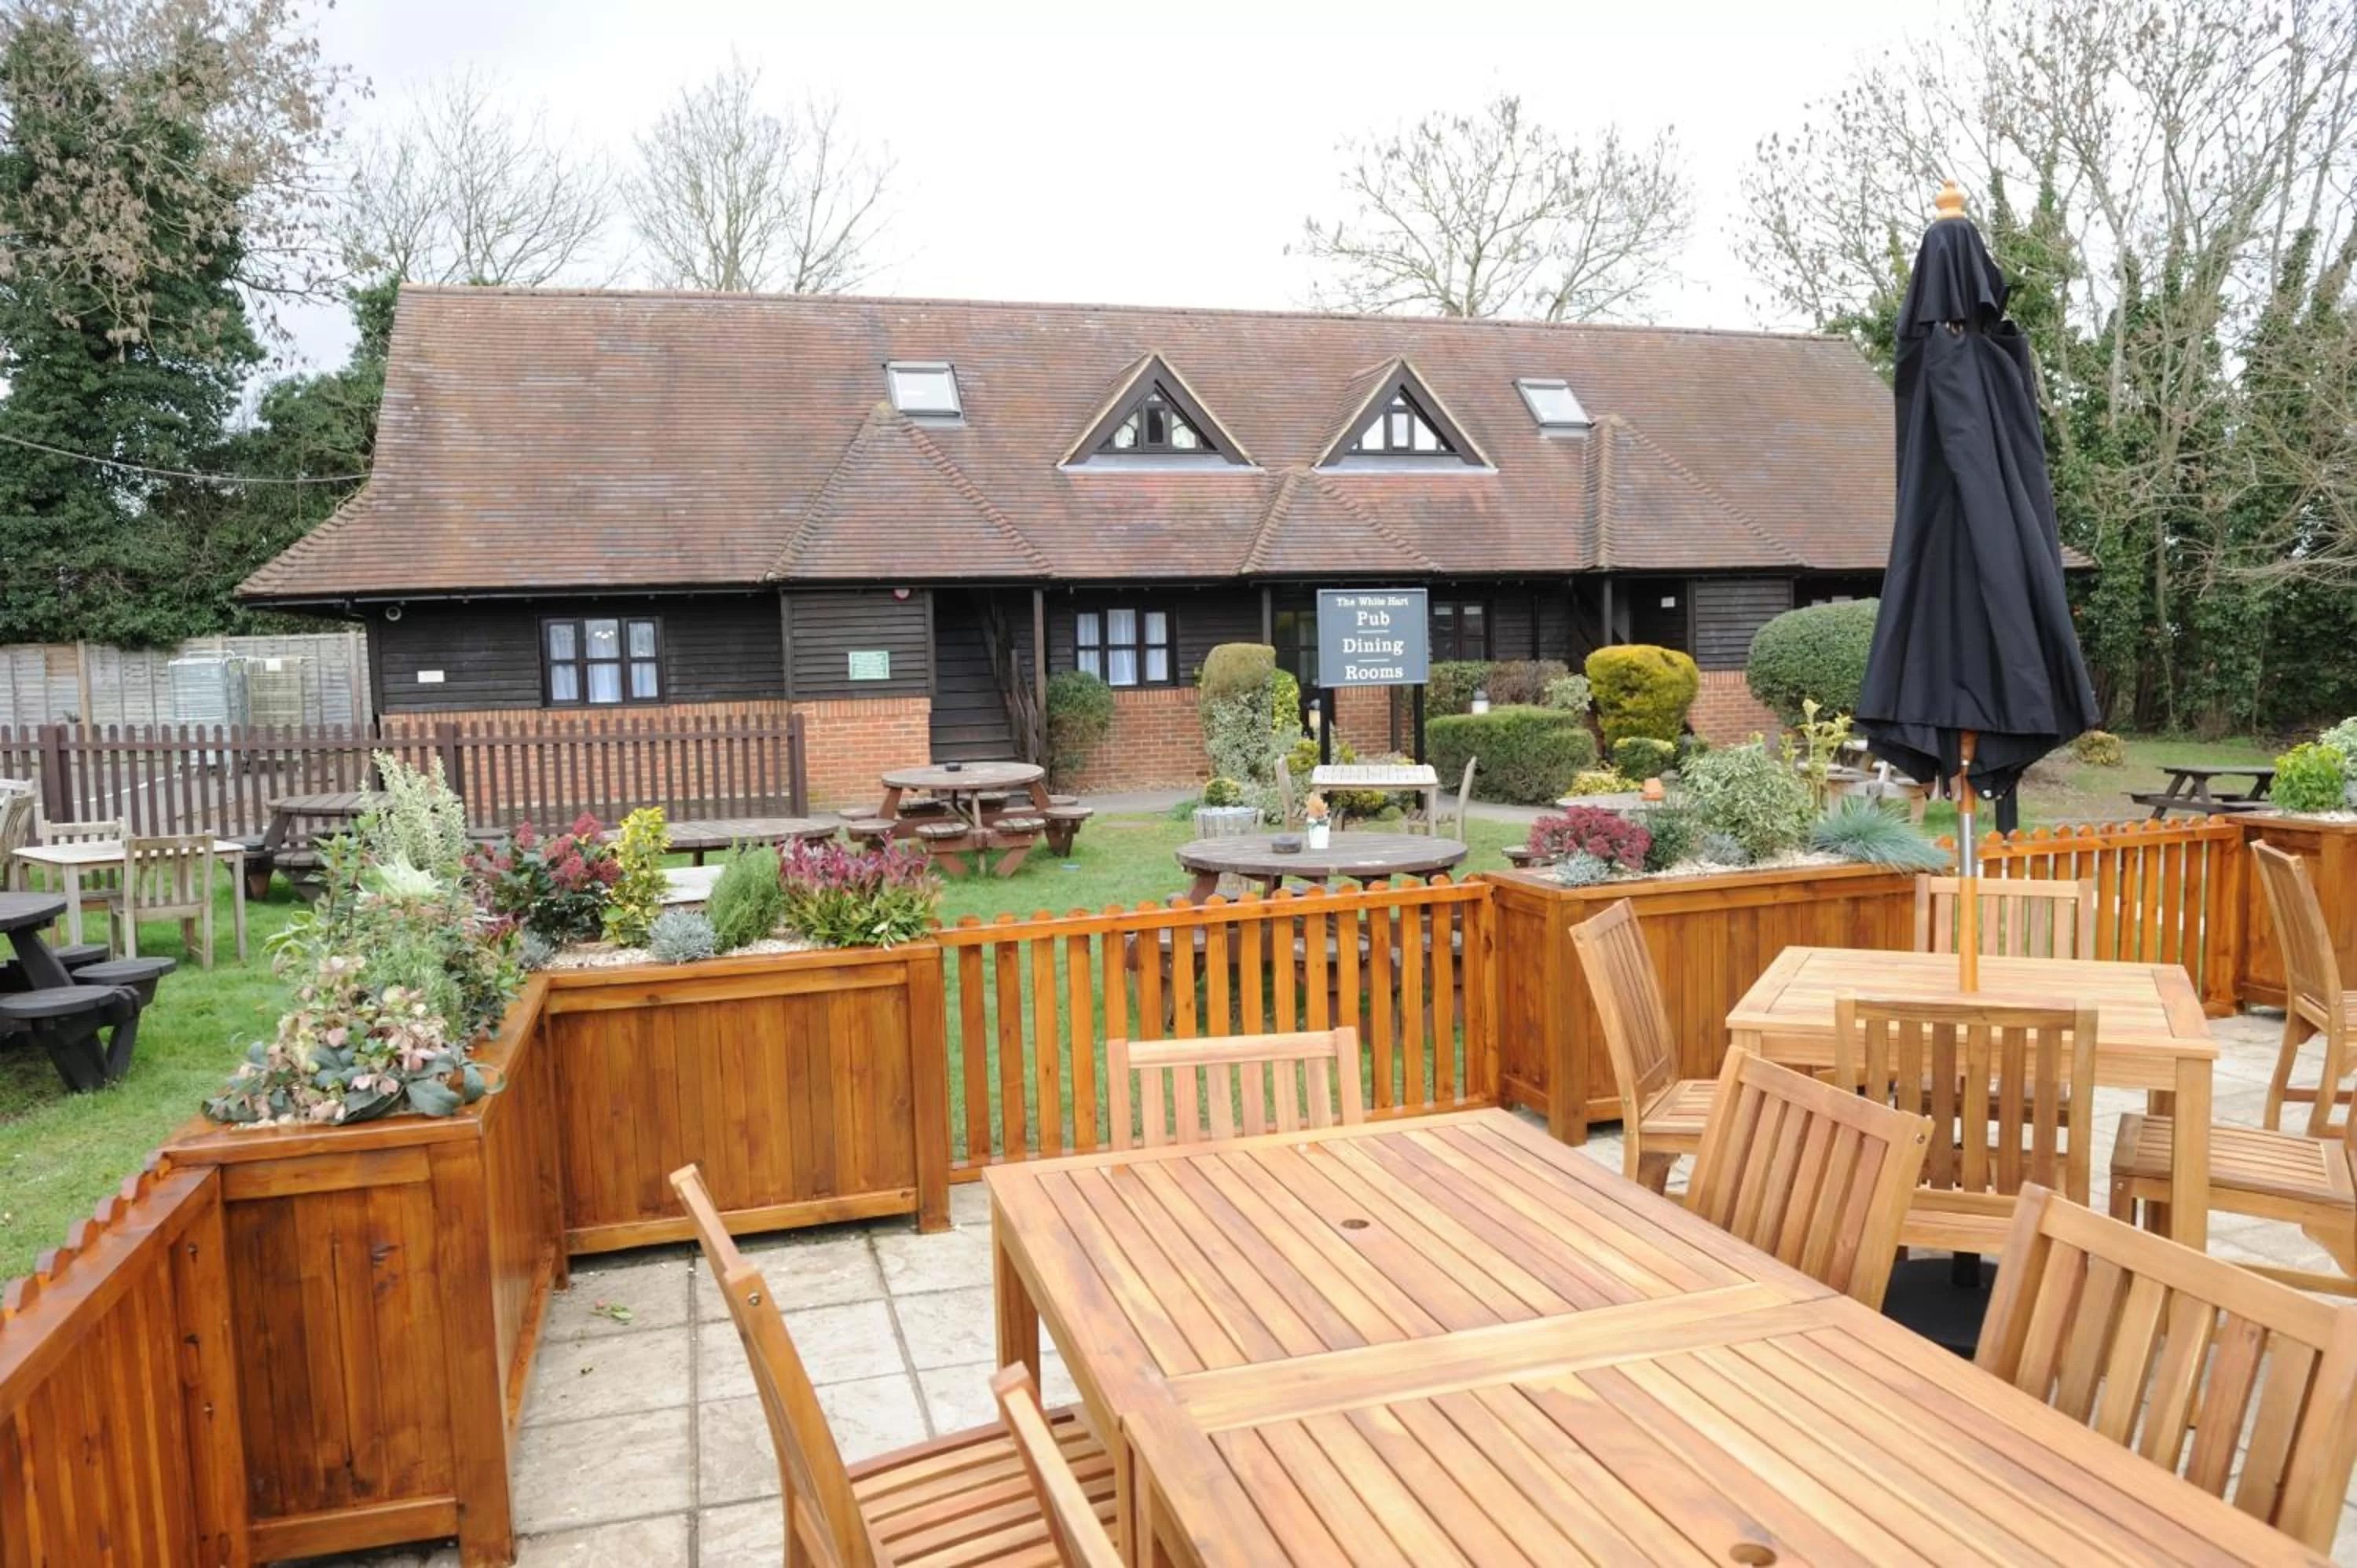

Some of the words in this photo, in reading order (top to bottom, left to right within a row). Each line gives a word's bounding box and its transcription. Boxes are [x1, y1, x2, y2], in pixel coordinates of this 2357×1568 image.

[1337, 597, 1355, 607] The
[1358, 596, 1386, 606] White
[1387, 596, 1409, 607] Hart
[1356, 610, 1390, 626] Pub
[1342, 637, 1405, 656] Dining
[1344, 665, 1403, 680] Rooms
